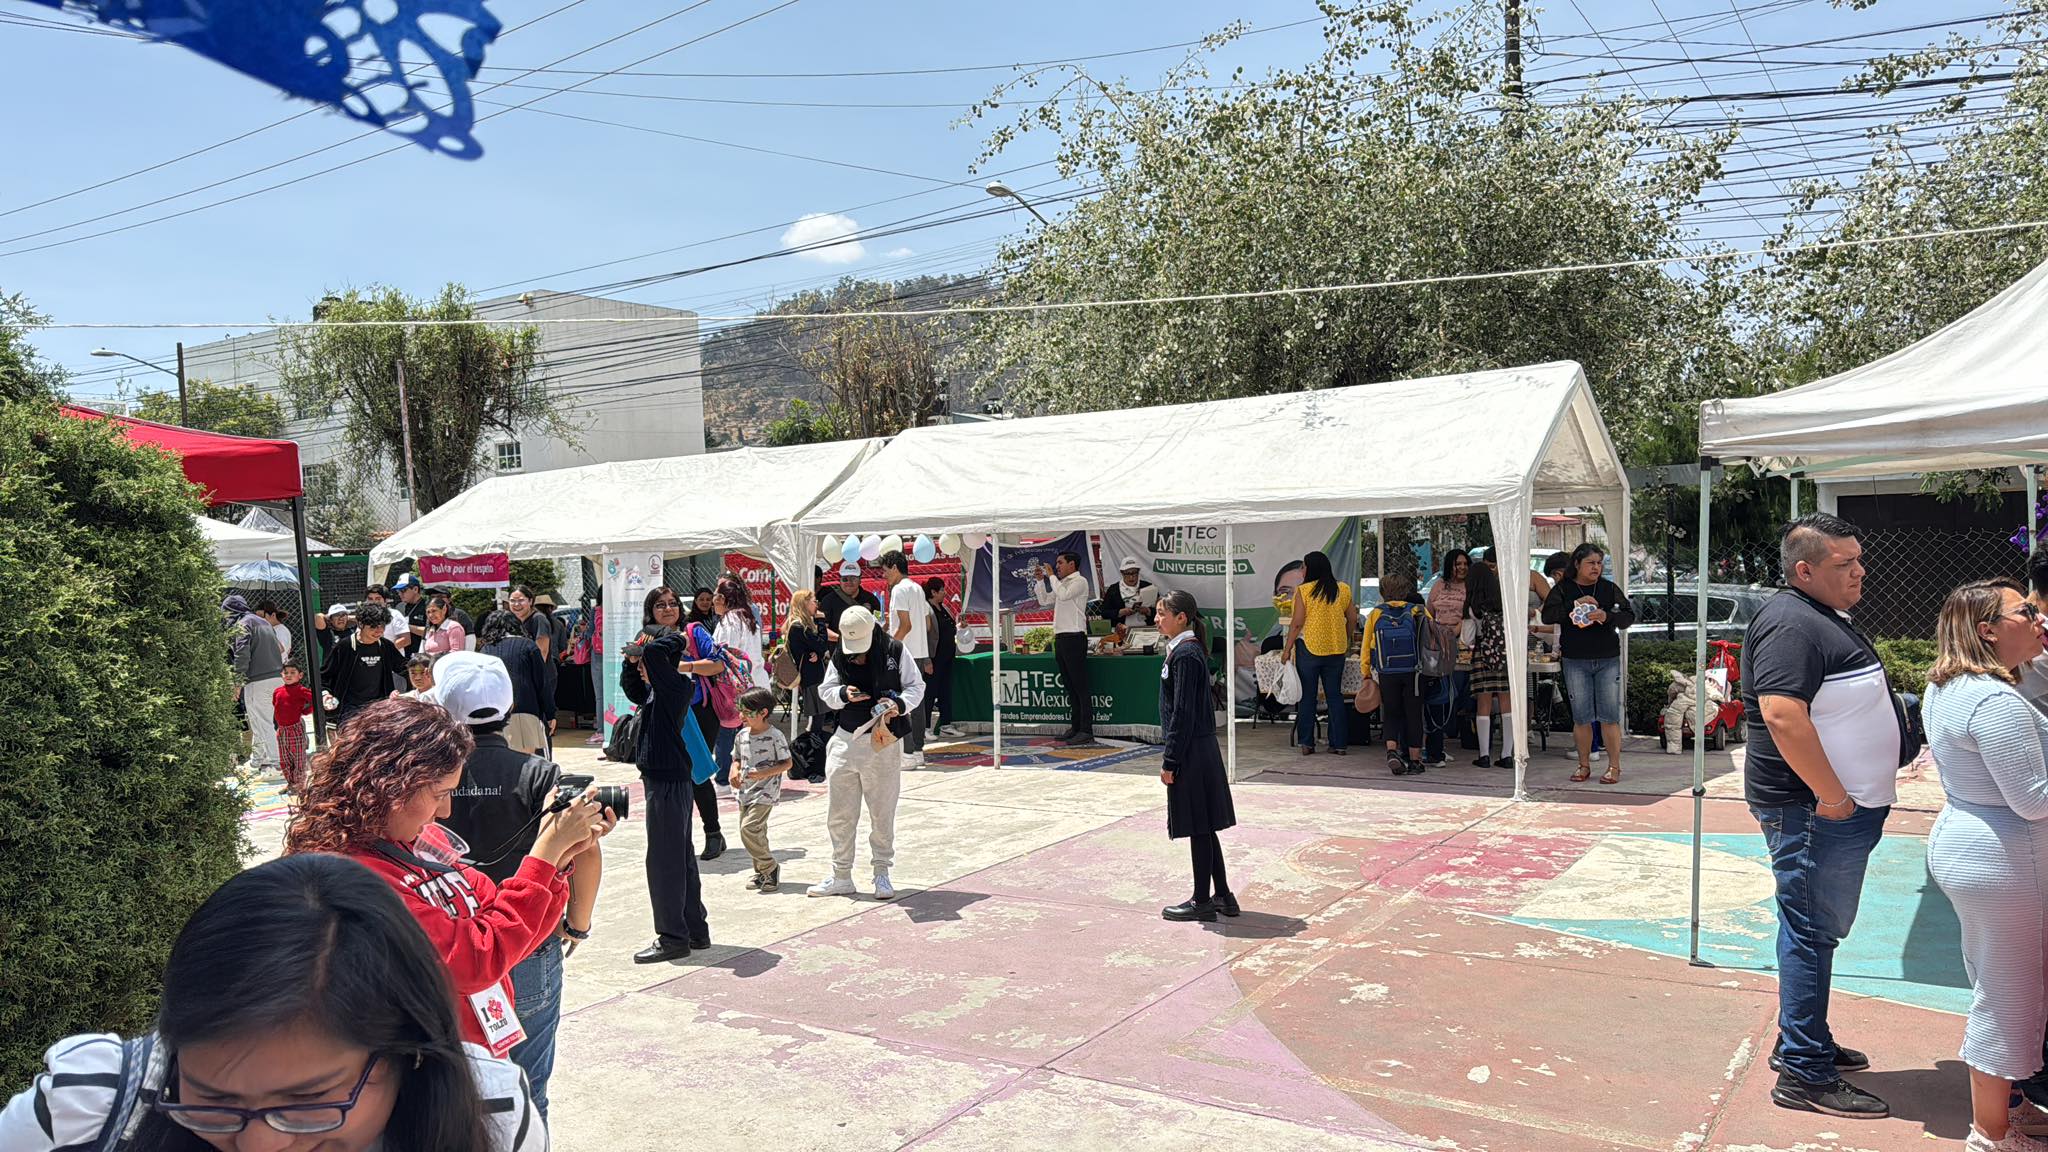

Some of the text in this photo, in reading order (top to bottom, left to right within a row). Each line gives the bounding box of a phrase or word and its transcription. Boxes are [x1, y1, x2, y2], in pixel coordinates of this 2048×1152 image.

[1184, 525, 1217, 539] TEC
[452, 565, 466, 576] por
[466, 564, 473, 573] el
[1031, 690, 1113, 711] Mexiqnse
[1000, 712, 1019, 720] randes
[1020, 712, 1065, 721] Emprendedores
[451, 785, 502, 797] udadana!
